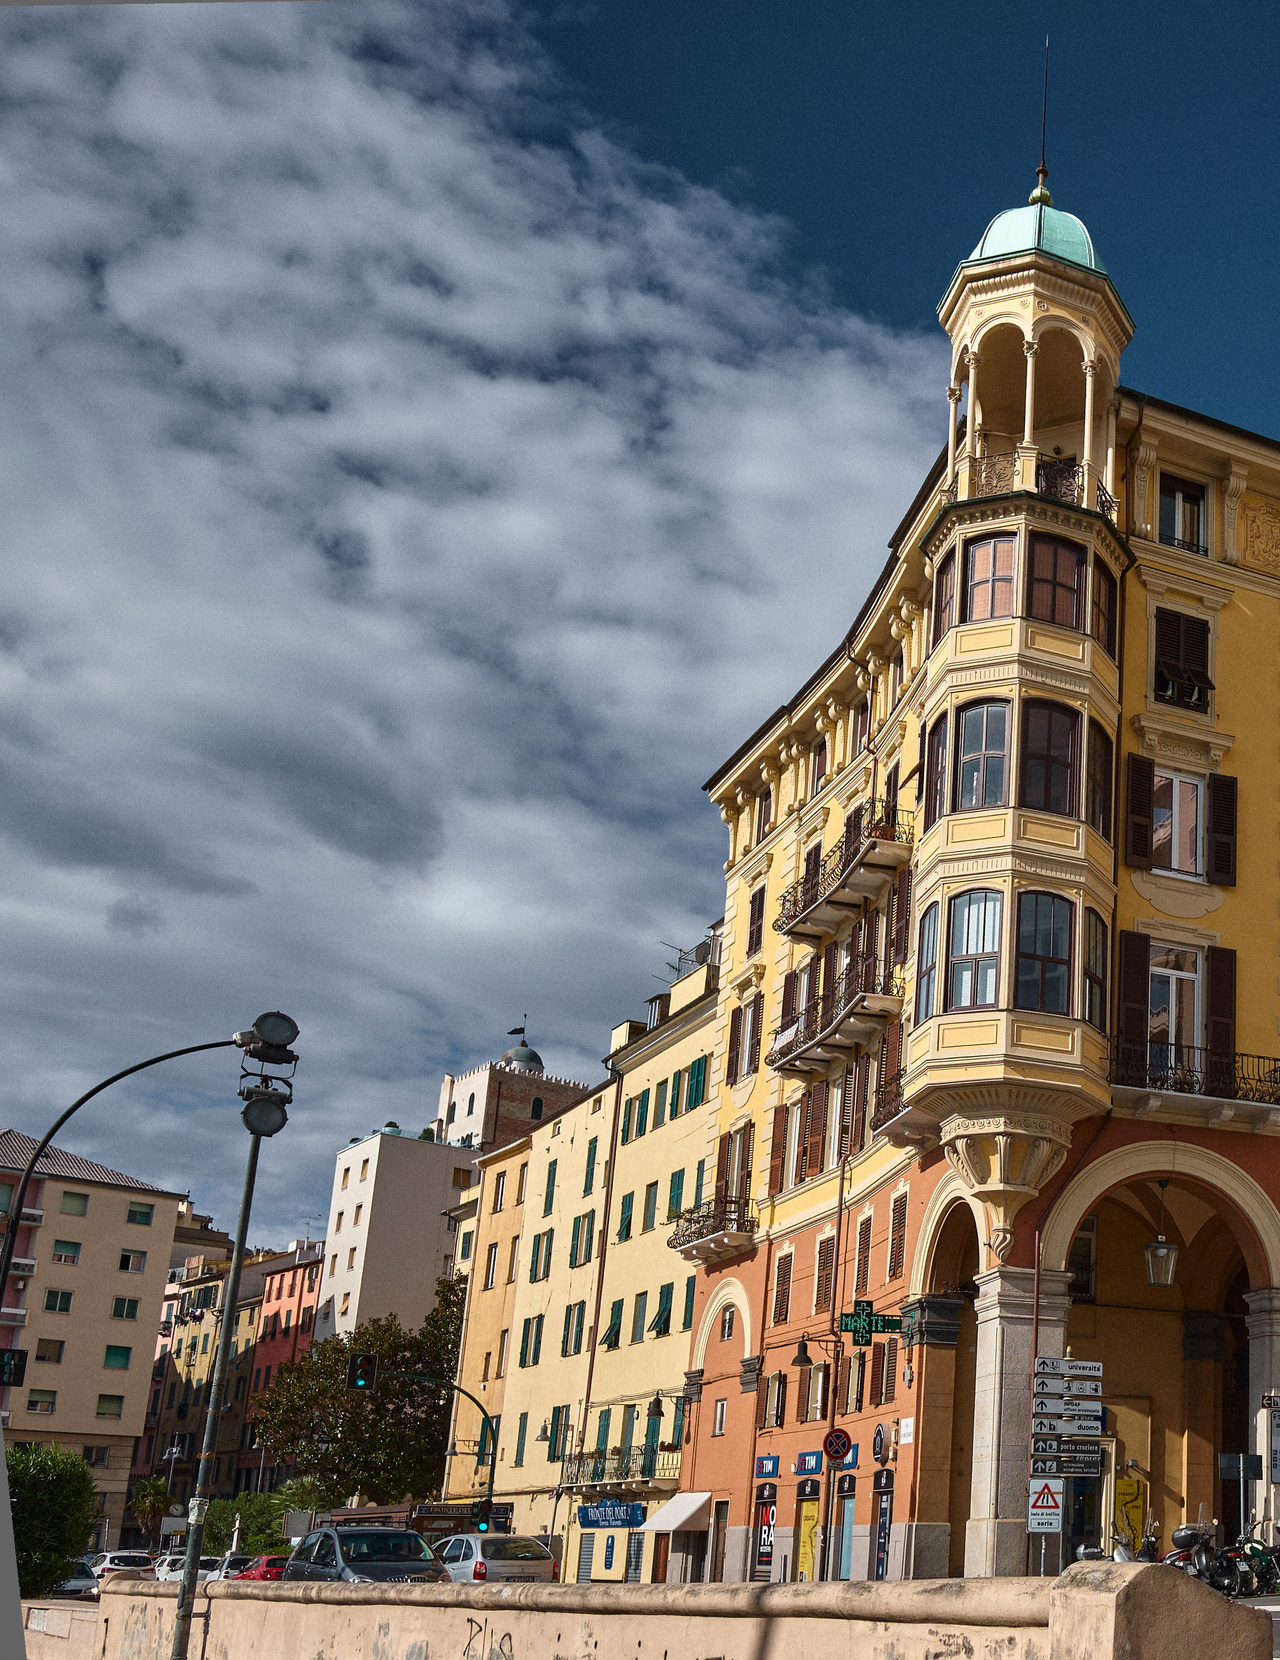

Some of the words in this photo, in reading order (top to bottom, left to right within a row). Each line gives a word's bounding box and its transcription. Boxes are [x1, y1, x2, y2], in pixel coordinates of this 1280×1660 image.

[842, 1315, 884, 1331] MARTE
[1060, 1443, 1075, 1451] porto
[763, 1460, 773, 1473] TIM
[805, 1455, 816, 1470] TIM
[429, 1506, 455, 1514] FRONTE
[588, 1508, 606, 1520] FRONTE
[605, 1507, 615, 1520] DEL
